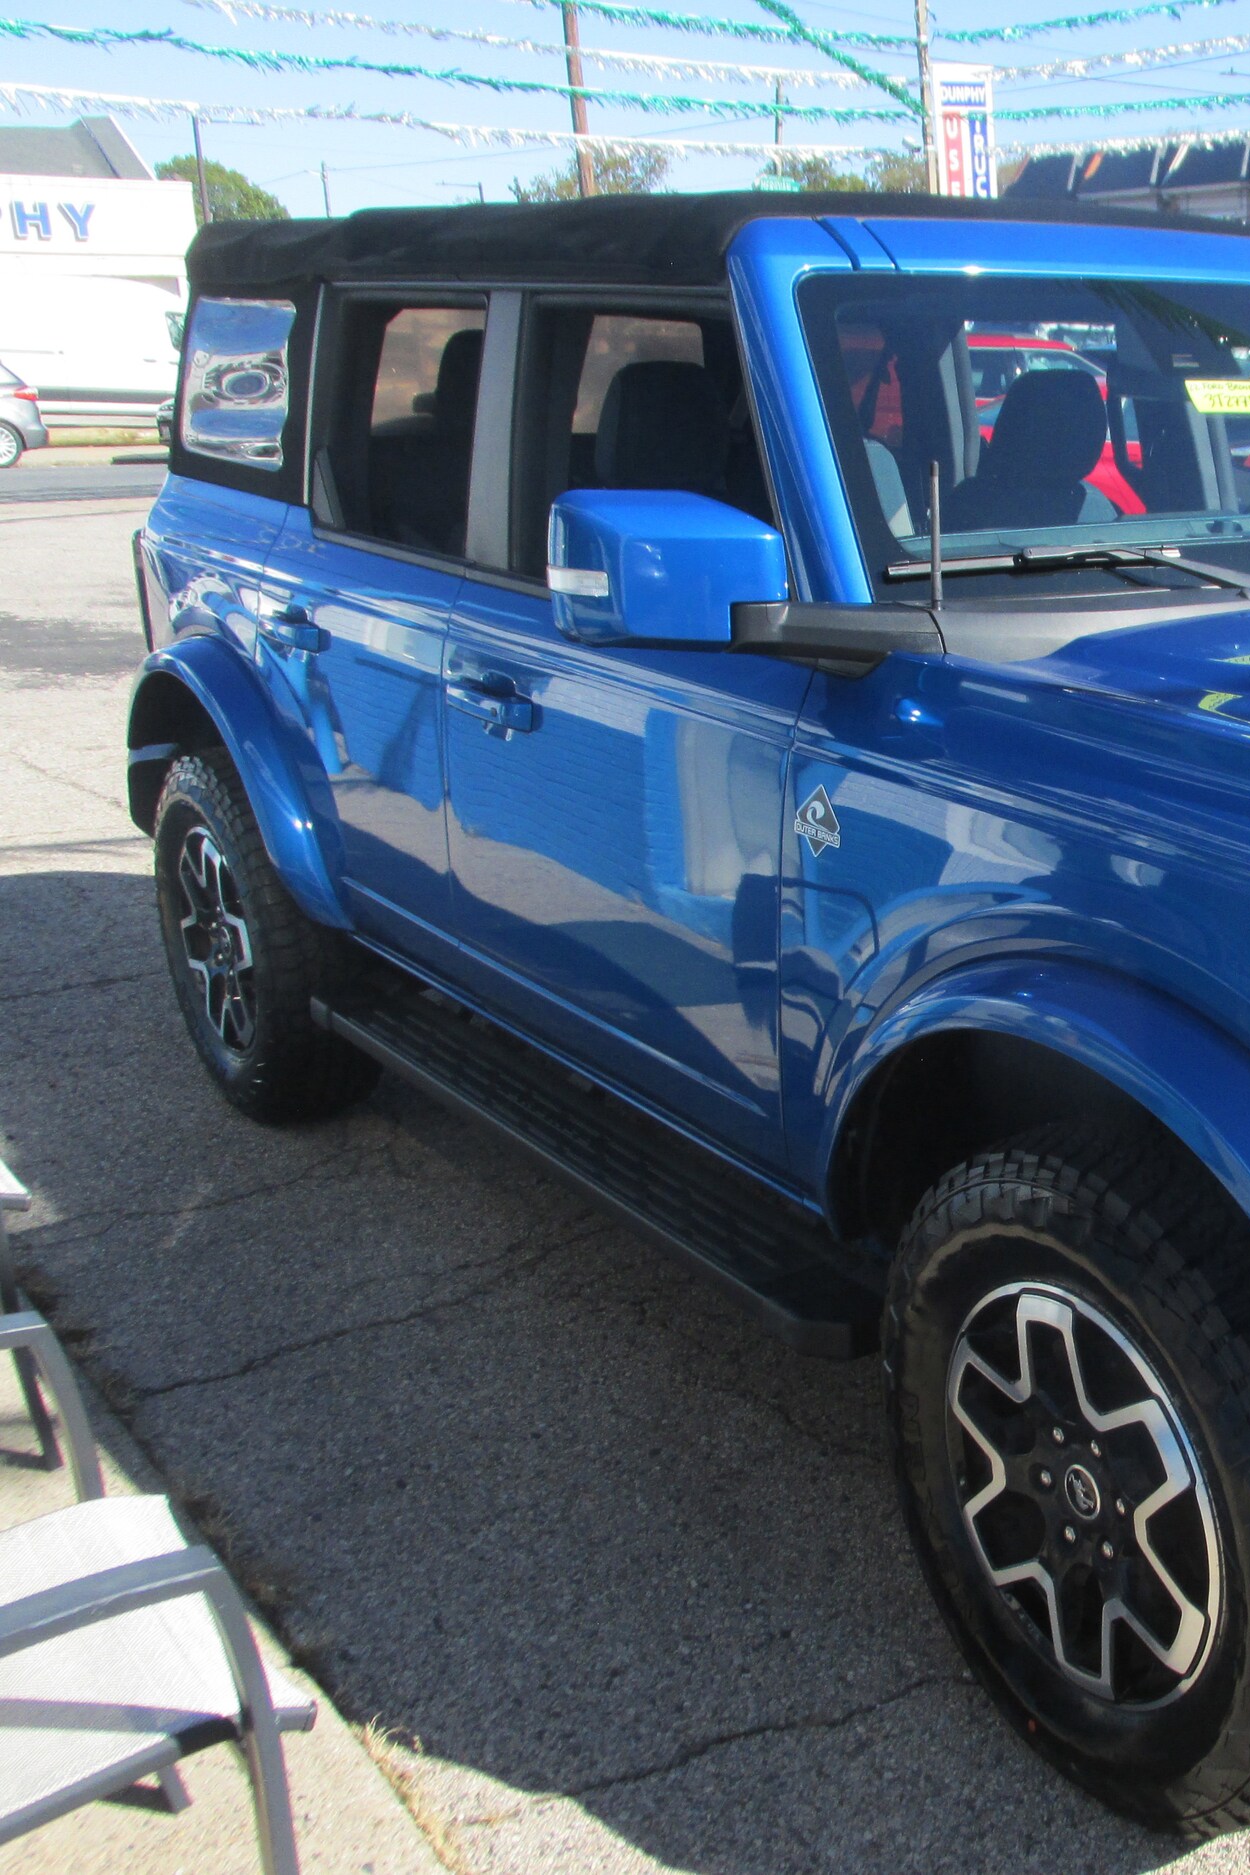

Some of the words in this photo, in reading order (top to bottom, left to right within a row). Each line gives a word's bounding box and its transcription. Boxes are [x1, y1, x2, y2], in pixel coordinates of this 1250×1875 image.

[942, 85, 985, 103] DUNPHY
[0, 200, 95, 241] HY
[796, 822, 817, 836] OUTER
[817, 830, 839, 845] BANKS
